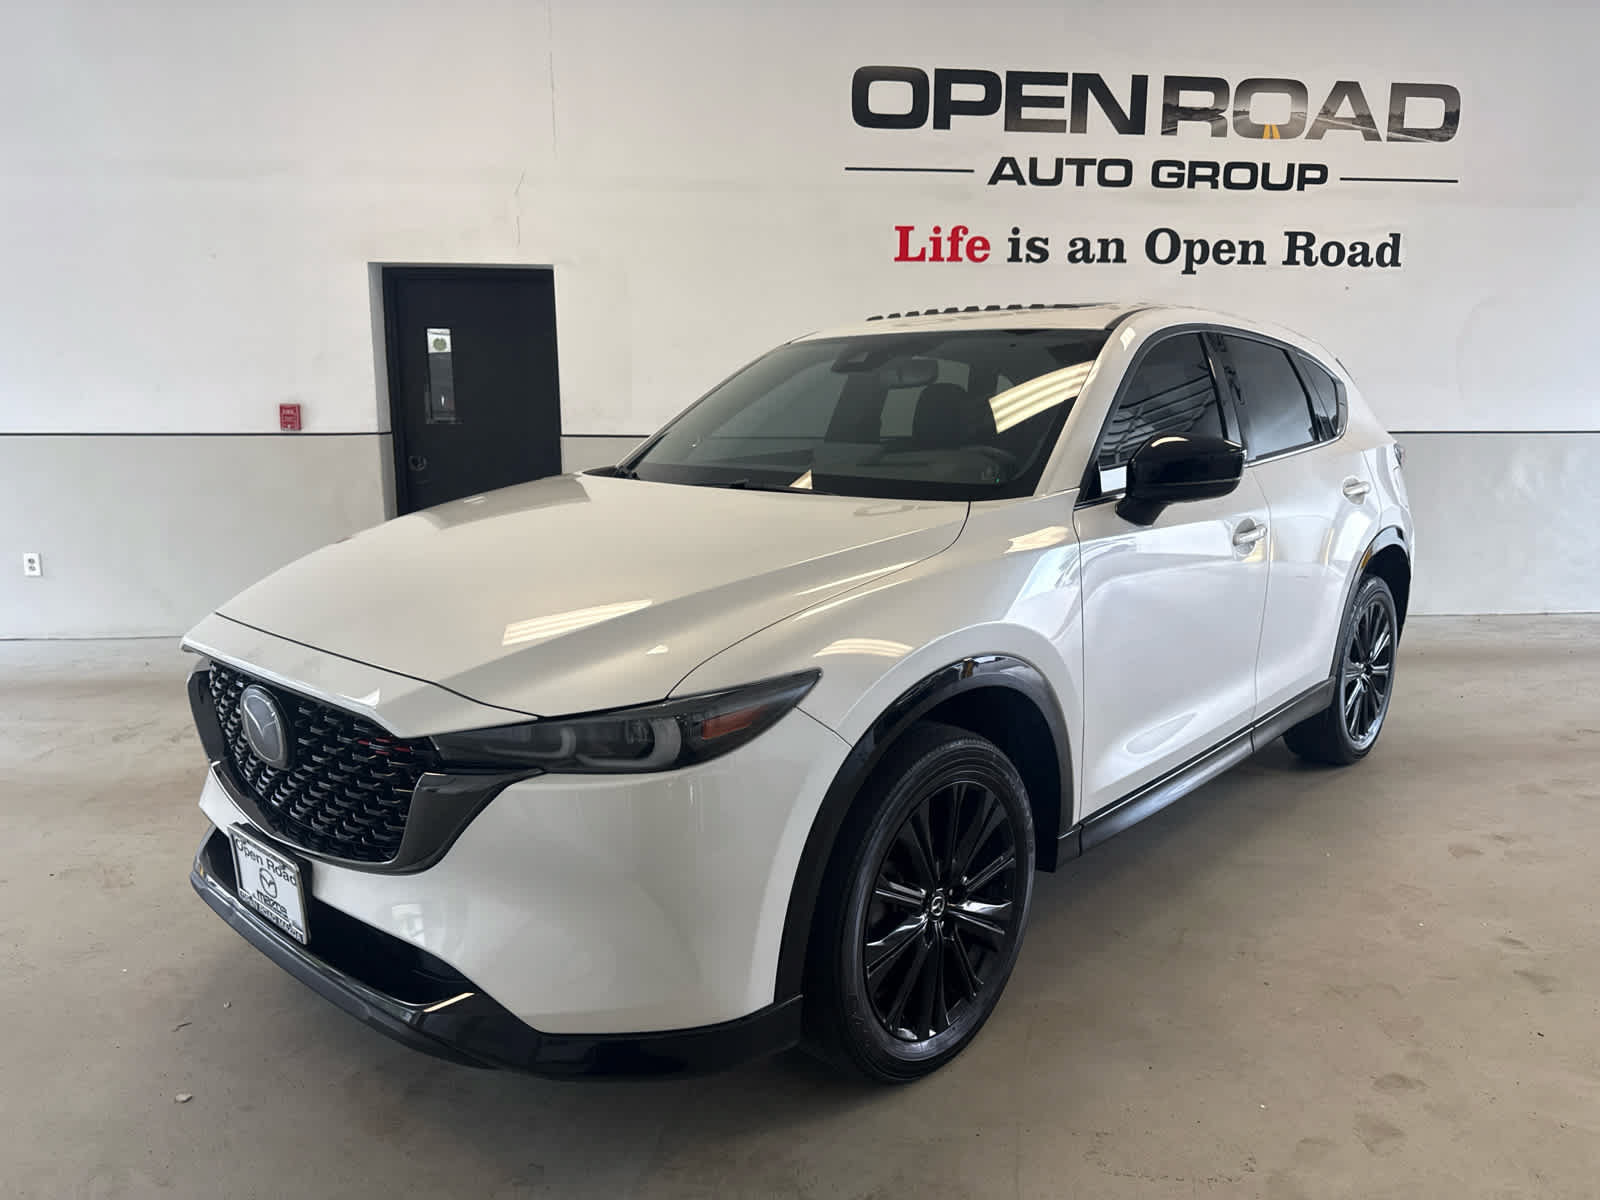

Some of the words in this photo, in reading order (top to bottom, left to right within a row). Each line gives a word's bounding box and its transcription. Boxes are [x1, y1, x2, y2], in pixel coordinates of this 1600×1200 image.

[852, 66, 1148, 135] OPEN
[1161, 75, 1461, 142] ROAD
[987, 157, 1134, 187] AUTO
[1151, 160, 1329, 191] GROUP
[894, 225, 991, 263] Life
[1007, 227, 1050, 263] is
[1068, 237, 1127, 264] an
[1145, 228, 1267, 275] Open
[1282, 231, 1403, 268] Road
[235, 838, 264, 865] Open
